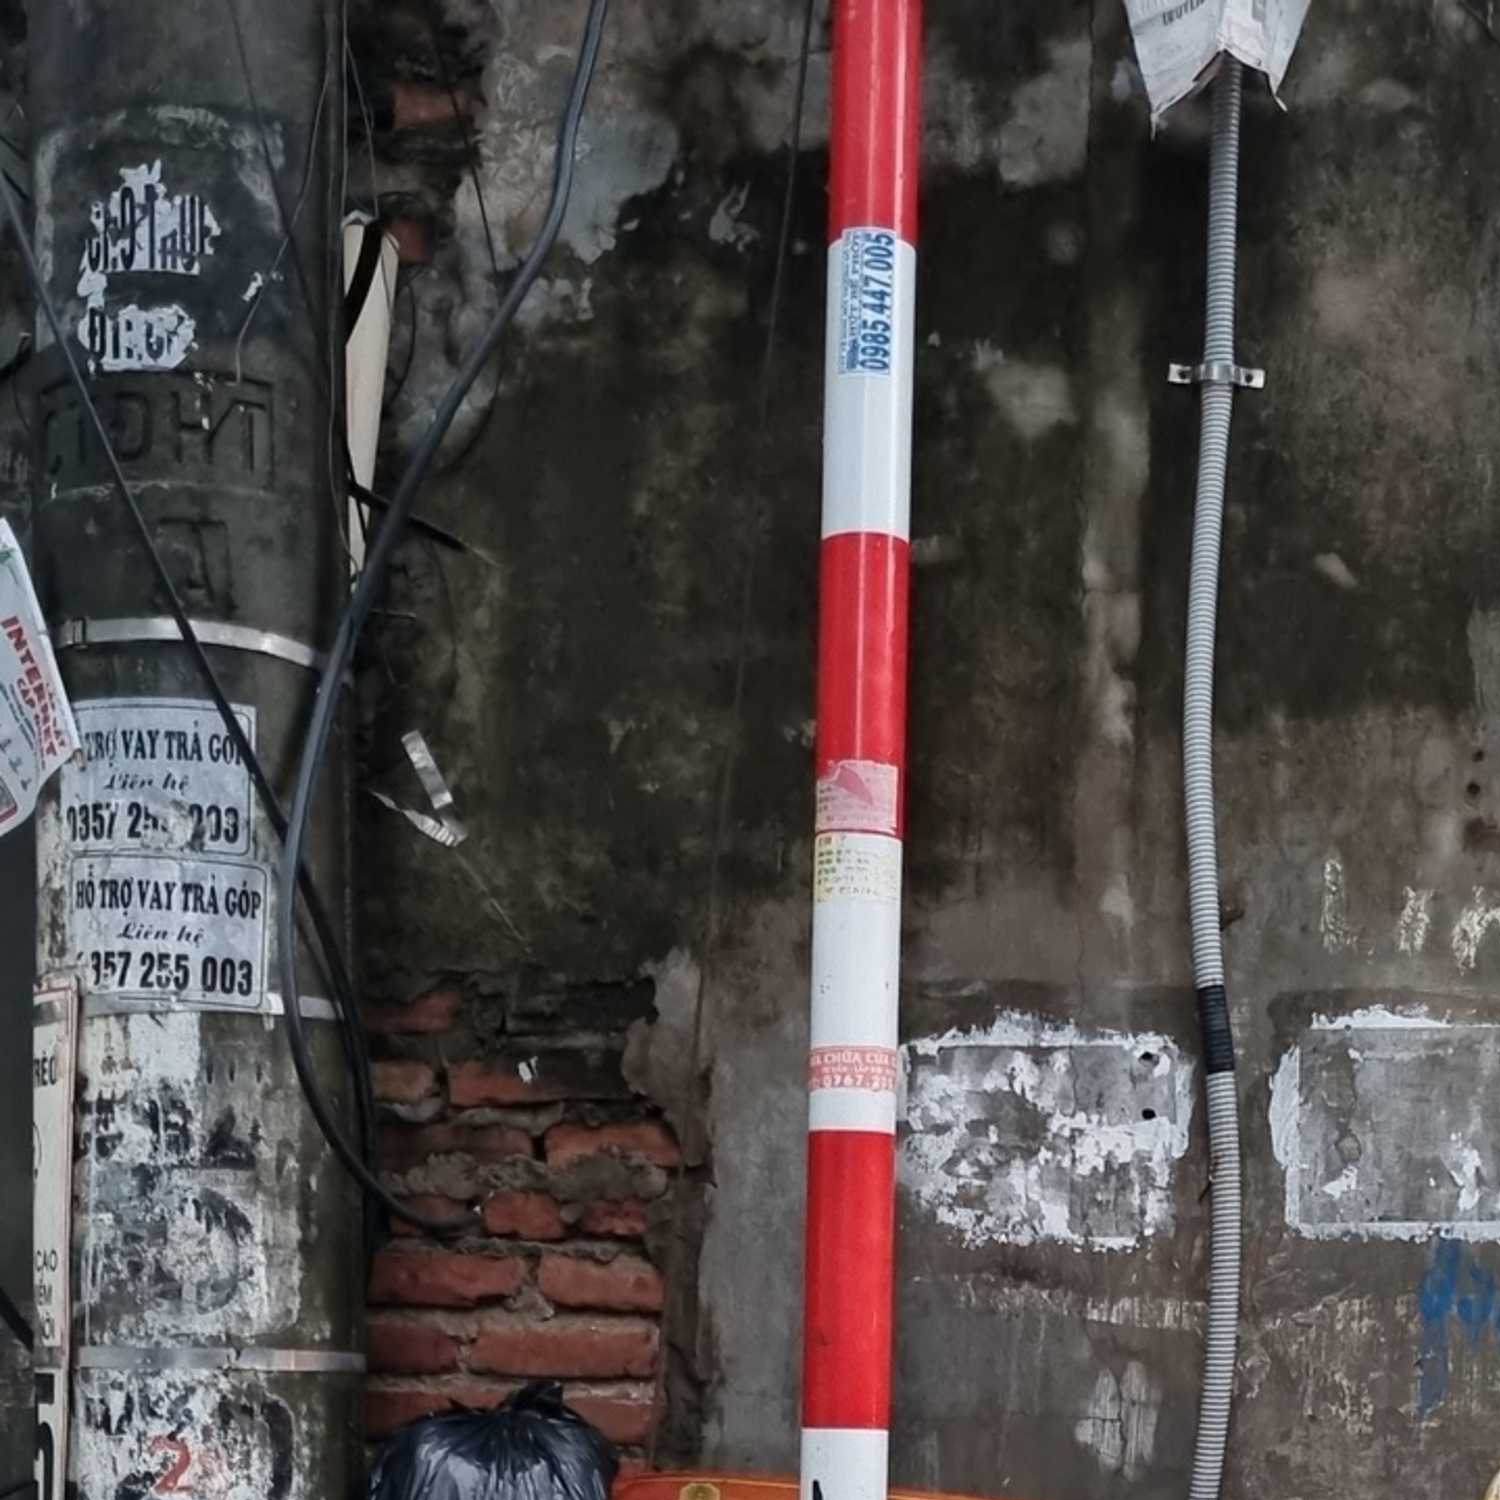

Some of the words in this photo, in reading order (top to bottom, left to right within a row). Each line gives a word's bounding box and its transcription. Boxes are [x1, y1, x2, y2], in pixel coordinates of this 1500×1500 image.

[859, 232, 895, 371] 0985.447.005
[122, 730, 160, 761] VAY
[165, 720, 203, 763] TRẢ
[99, 876, 134, 917] TRỢ
[138, 880, 177, 911] VAY
[181, 874, 219, 916] TRẢ
[224, 880, 261, 920] GÓP
[140, 952, 190, 991] 255
[201, 956, 253, 997] 003
